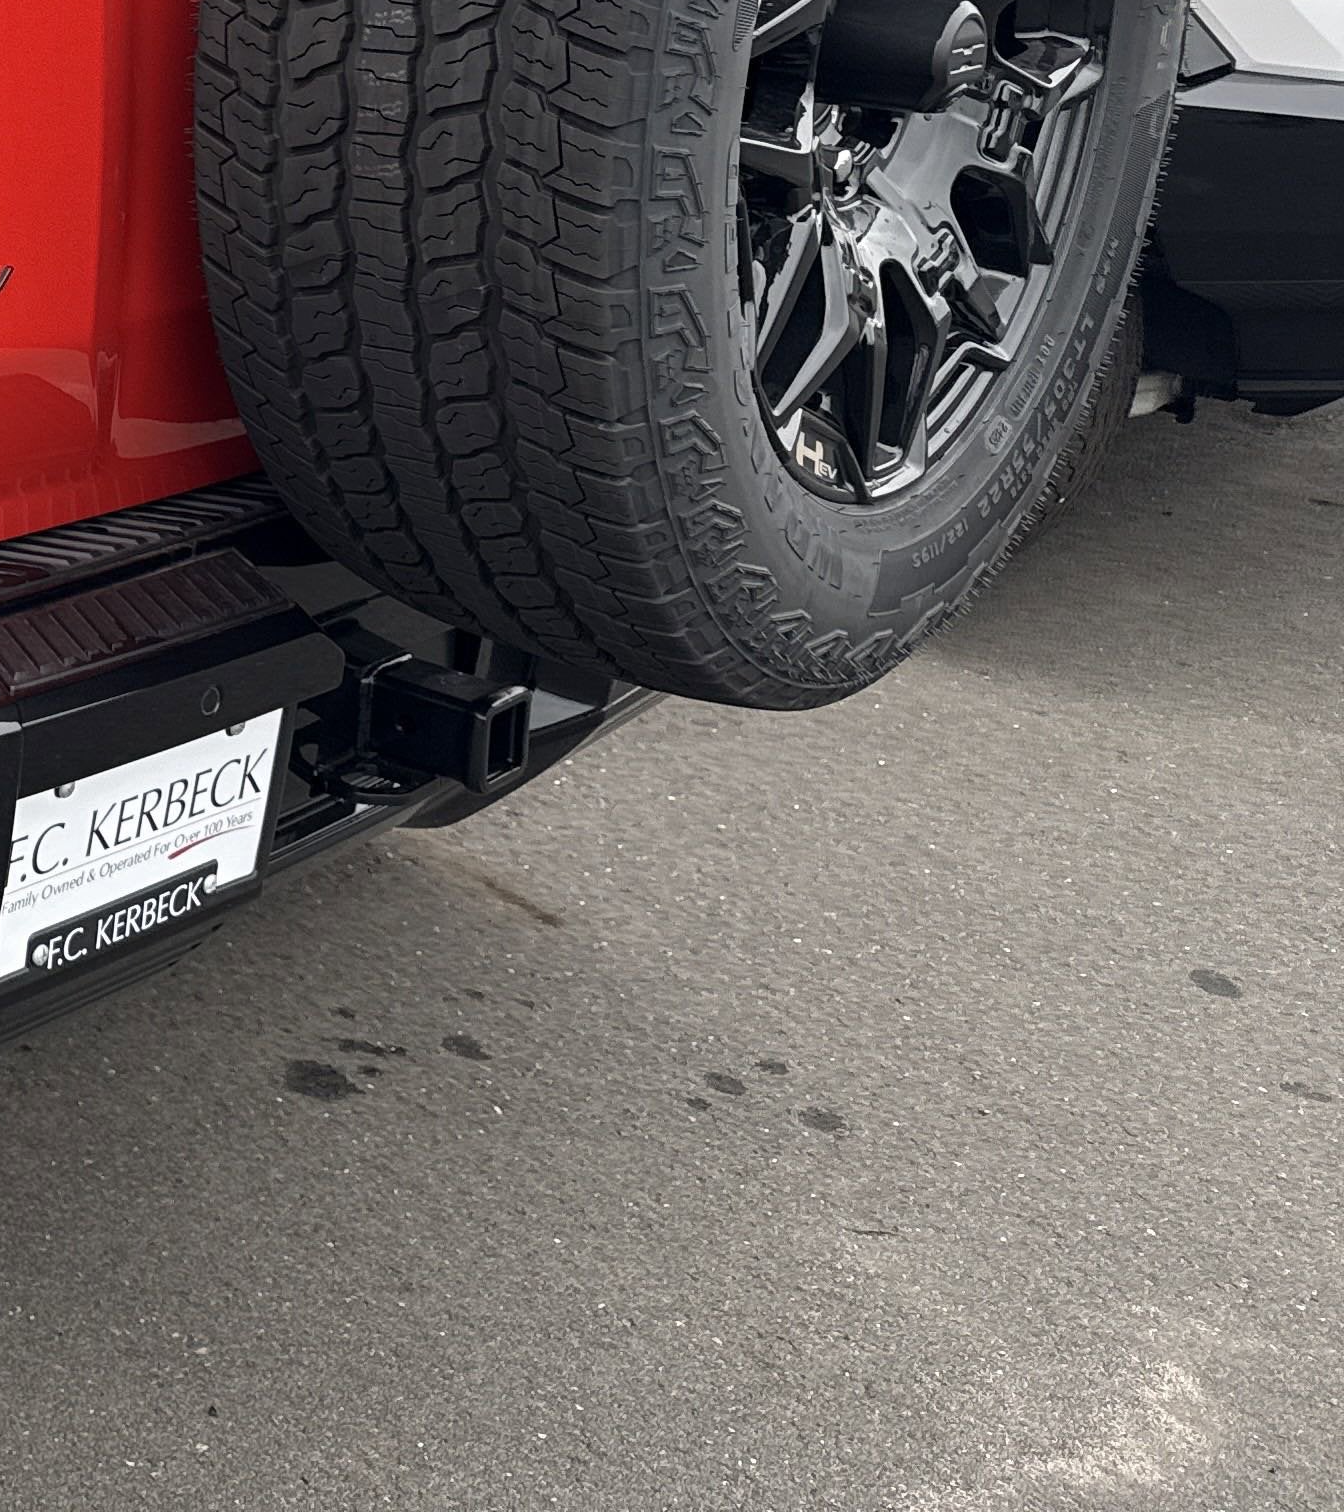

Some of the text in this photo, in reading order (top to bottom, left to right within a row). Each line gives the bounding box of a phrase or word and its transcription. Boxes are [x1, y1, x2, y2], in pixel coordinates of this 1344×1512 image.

[86, 748, 268, 857] KERBECK
[2, 811, 253, 915] Family Owned & Operated For Over 100 Years
[47, 877, 205, 970] F.C. KERBECK
